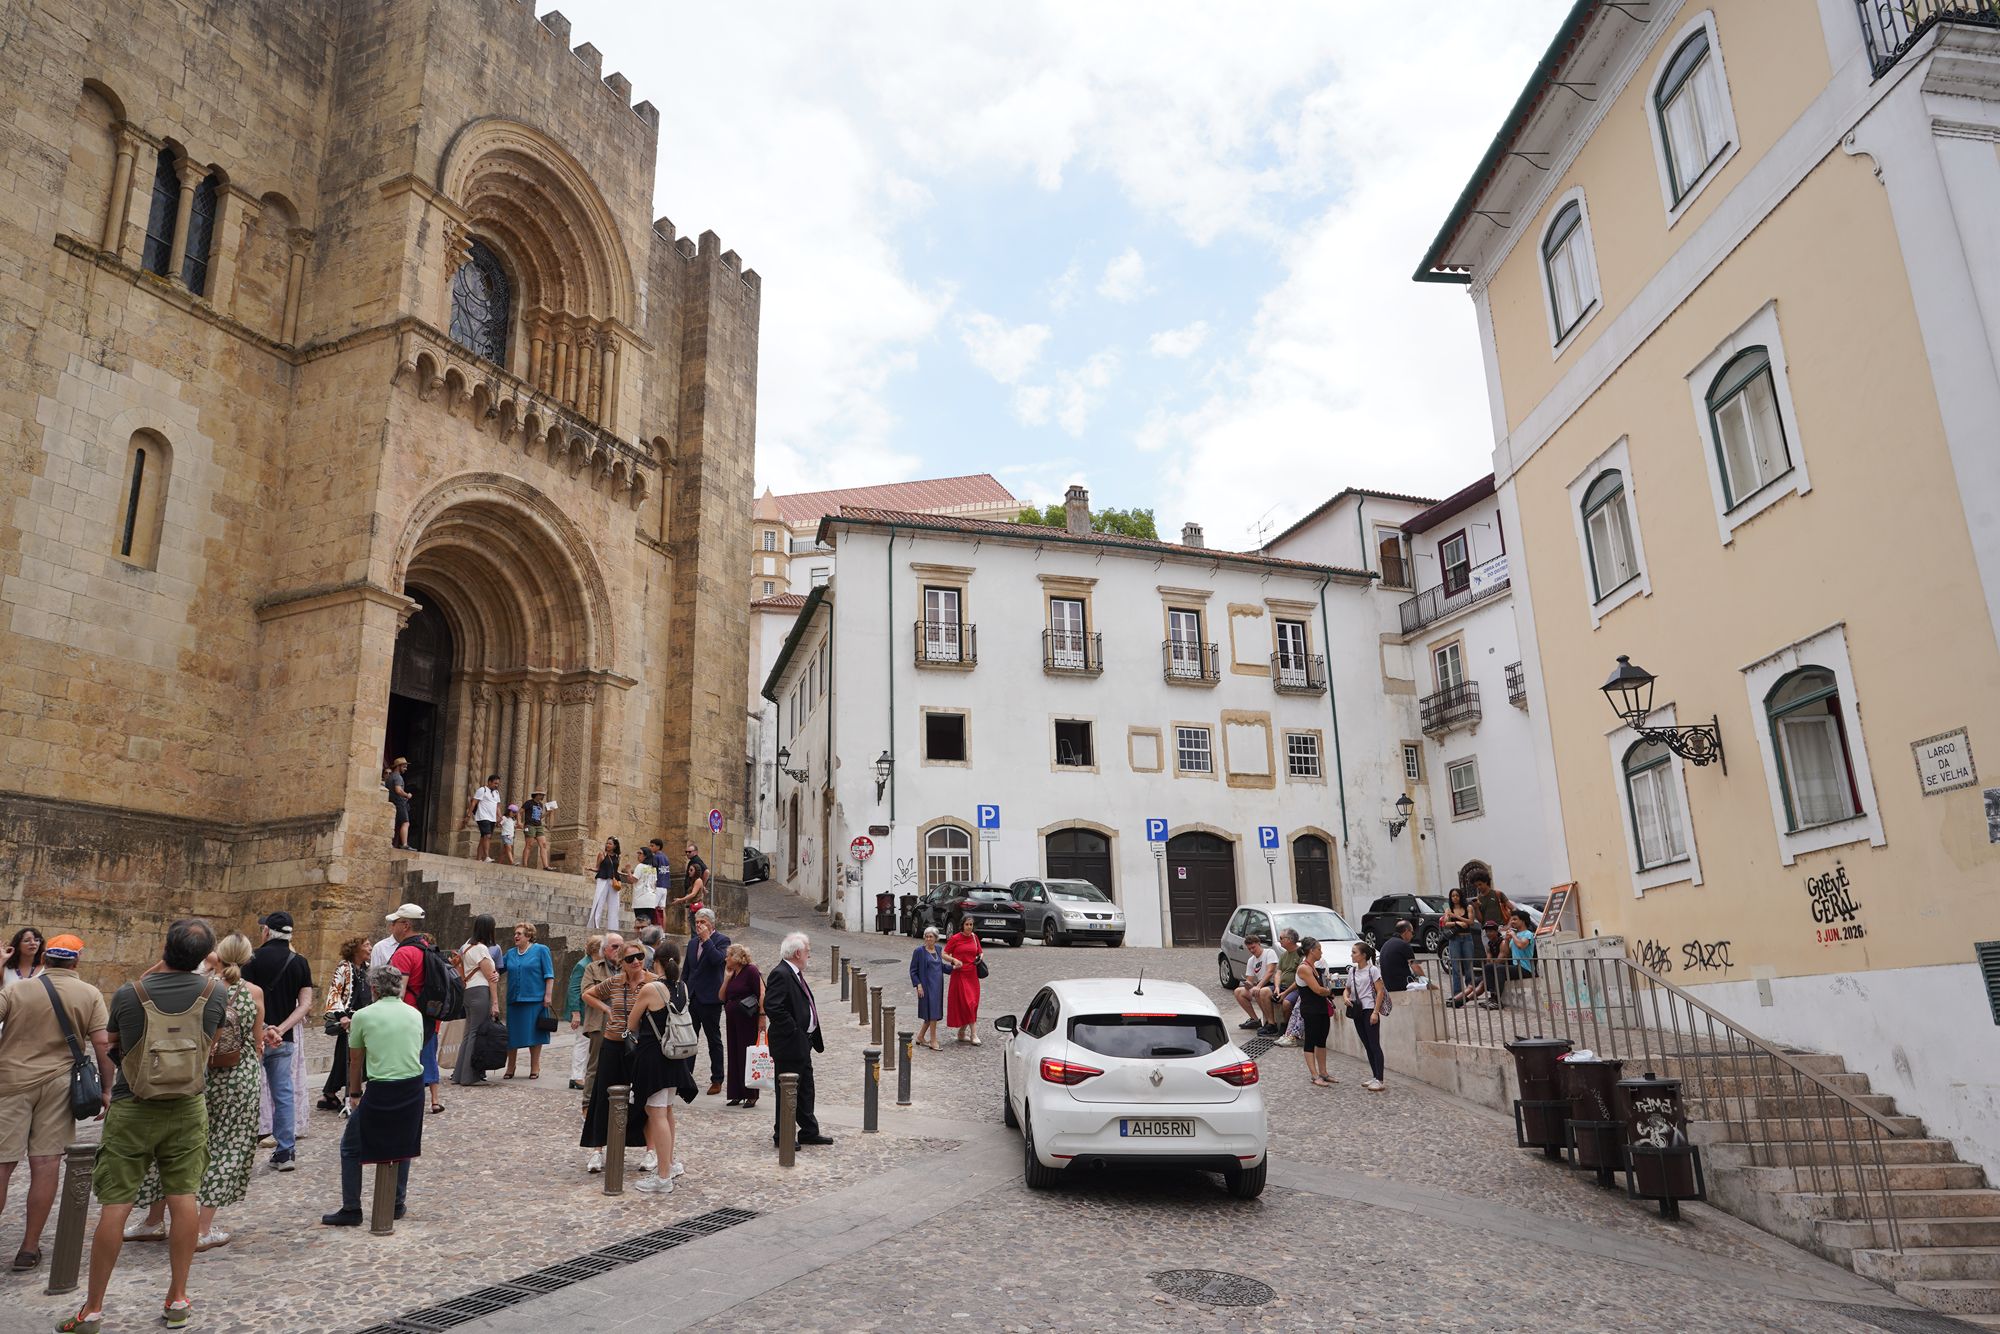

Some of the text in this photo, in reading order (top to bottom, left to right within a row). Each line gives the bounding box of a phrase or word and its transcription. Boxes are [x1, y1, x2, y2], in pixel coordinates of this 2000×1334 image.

[1927, 742, 1955, 759] LARGO
[1938, 758, 1950, 770] DA
[1926, 767, 1969, 786] SE VELHA
[982, 806, 995, 826] P
[1150, 820, 1164, 839] P
[1262, 828, 1274, 846] P
[1807, 866, 1850, 900] GREVE
[1811, 888, 1860, 924] GERAL
[1816, 924, 1864, 943] 3 JUN. 2026
[1132, 1122, 1190, 1135] AH05RN
